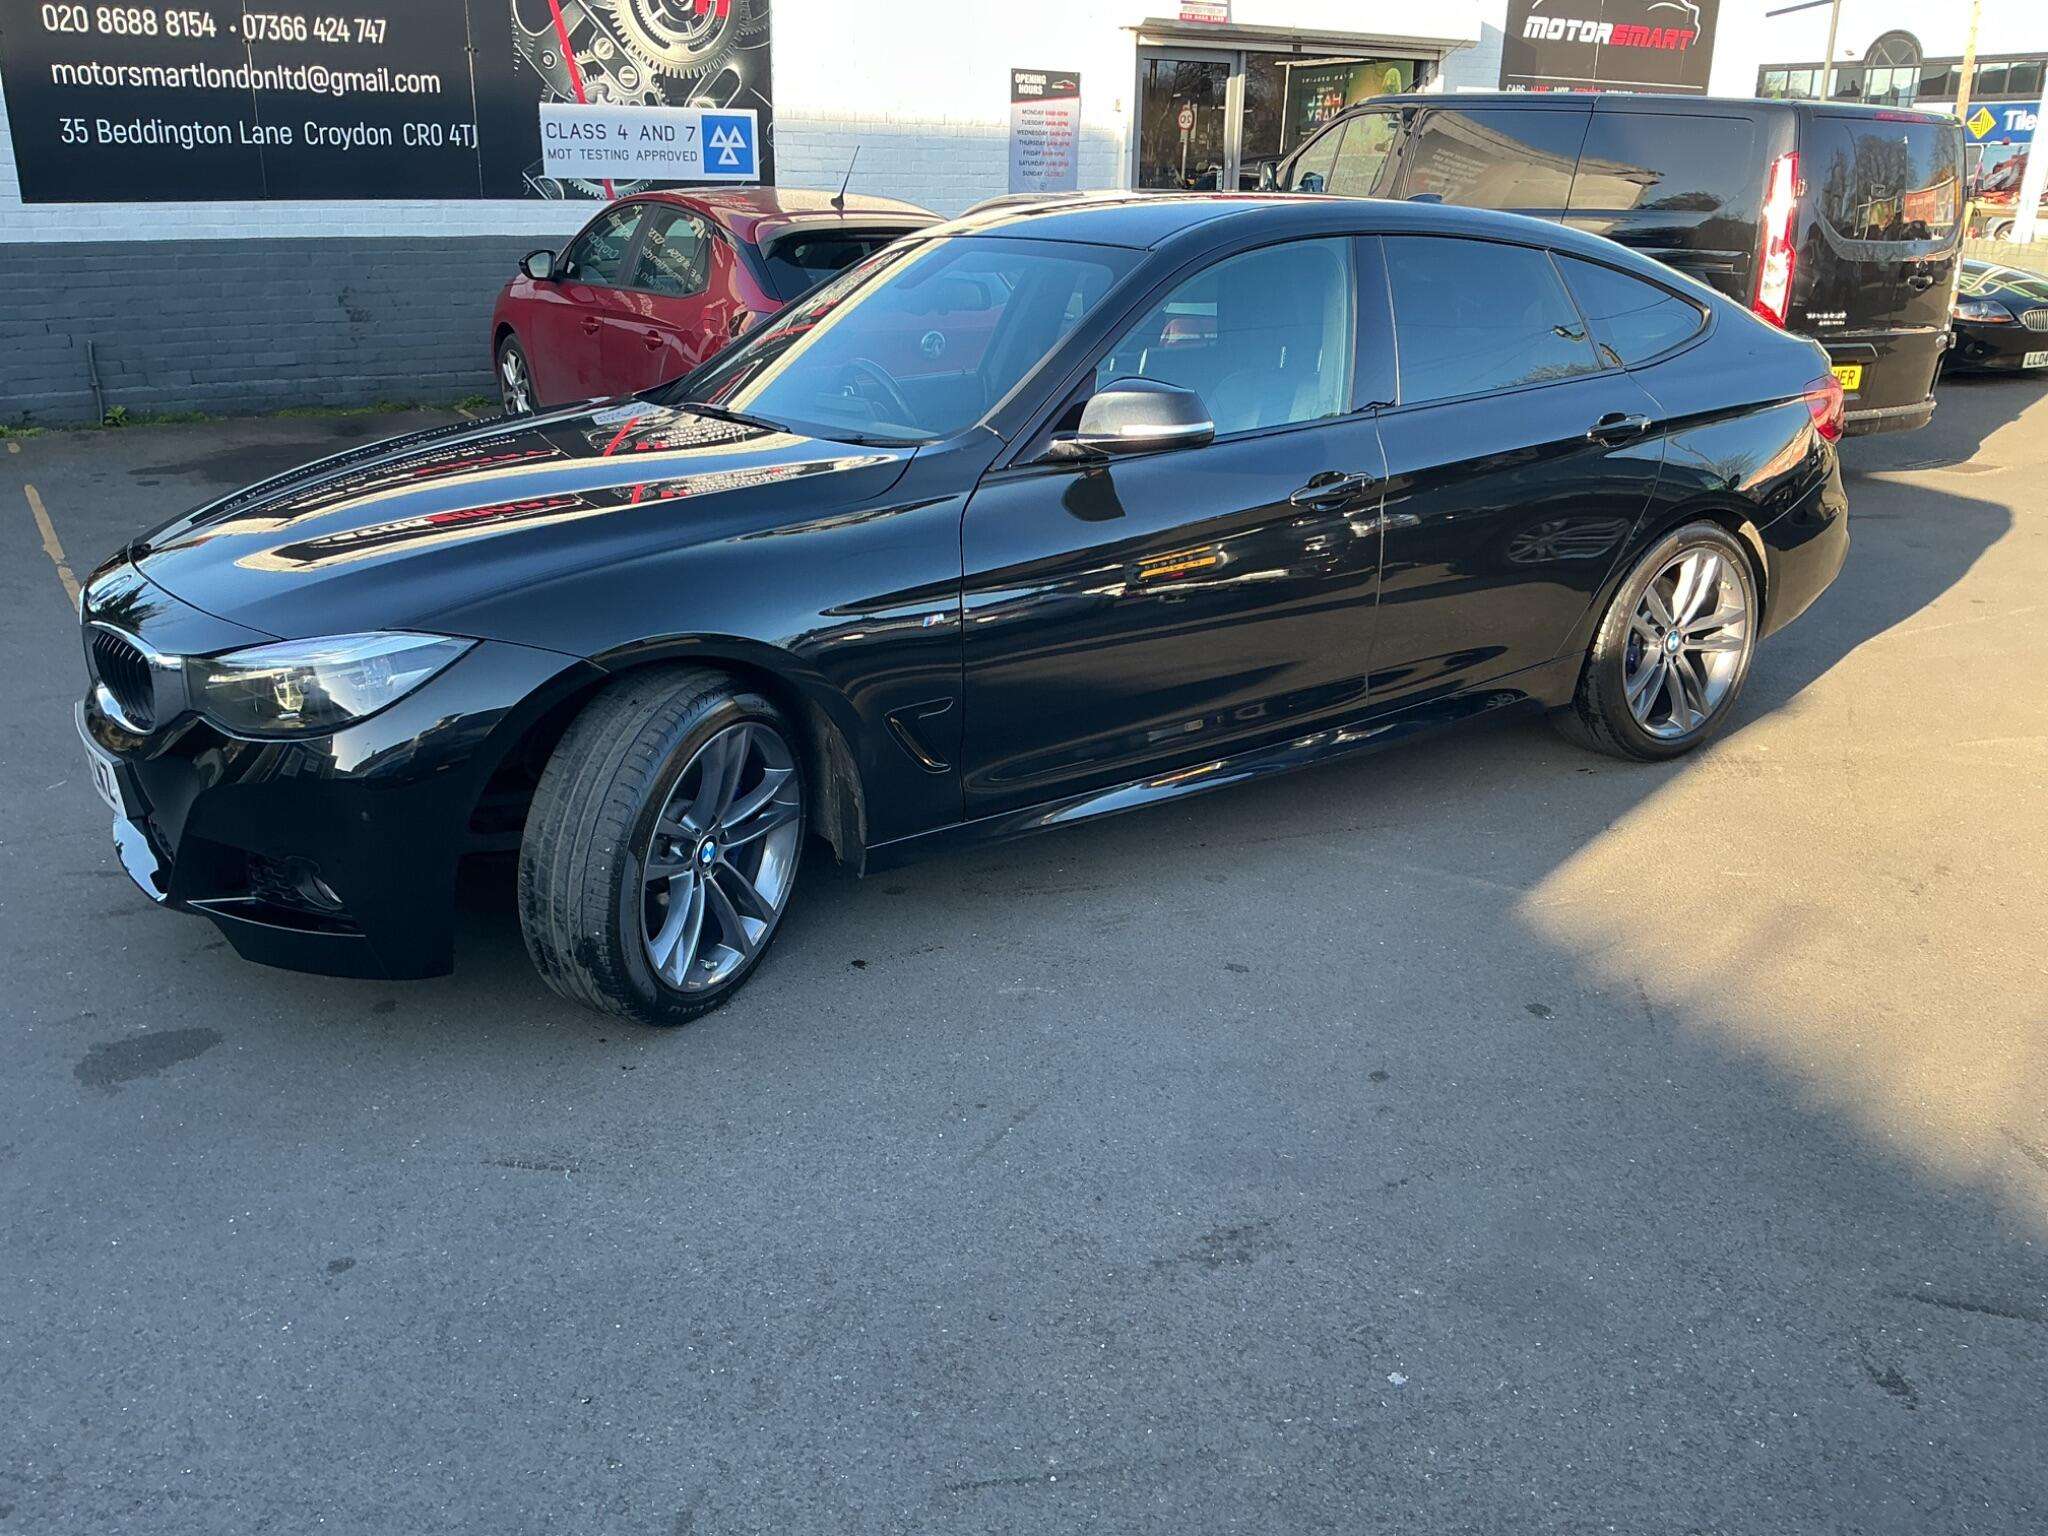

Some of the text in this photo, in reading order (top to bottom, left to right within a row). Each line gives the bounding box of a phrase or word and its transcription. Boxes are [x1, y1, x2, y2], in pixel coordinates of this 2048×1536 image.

[42, 4, 386, 44] 020 8688 8154 07366 424 747
[1522, 15, 1695, 51] MOTORSMART
[51, 61, 441, 96] motorsmartlondonltd@gmail.com
[1015, 73, 1046, 85] OPENING
[1019, 84, 1043, 95] HOURS
[59, 118, 88, 144] 35
[96, 119, 232, 150] Beddington
[239, 121, 293, 145] Lane
[304, 121, 392, 151] Croydon
[450, 124, 478, 149] 4TJ
[546, 122, 696, 142] CLASS 4 AND 7
[548, 149, 698, 162] MOT TESTING APPROVED
